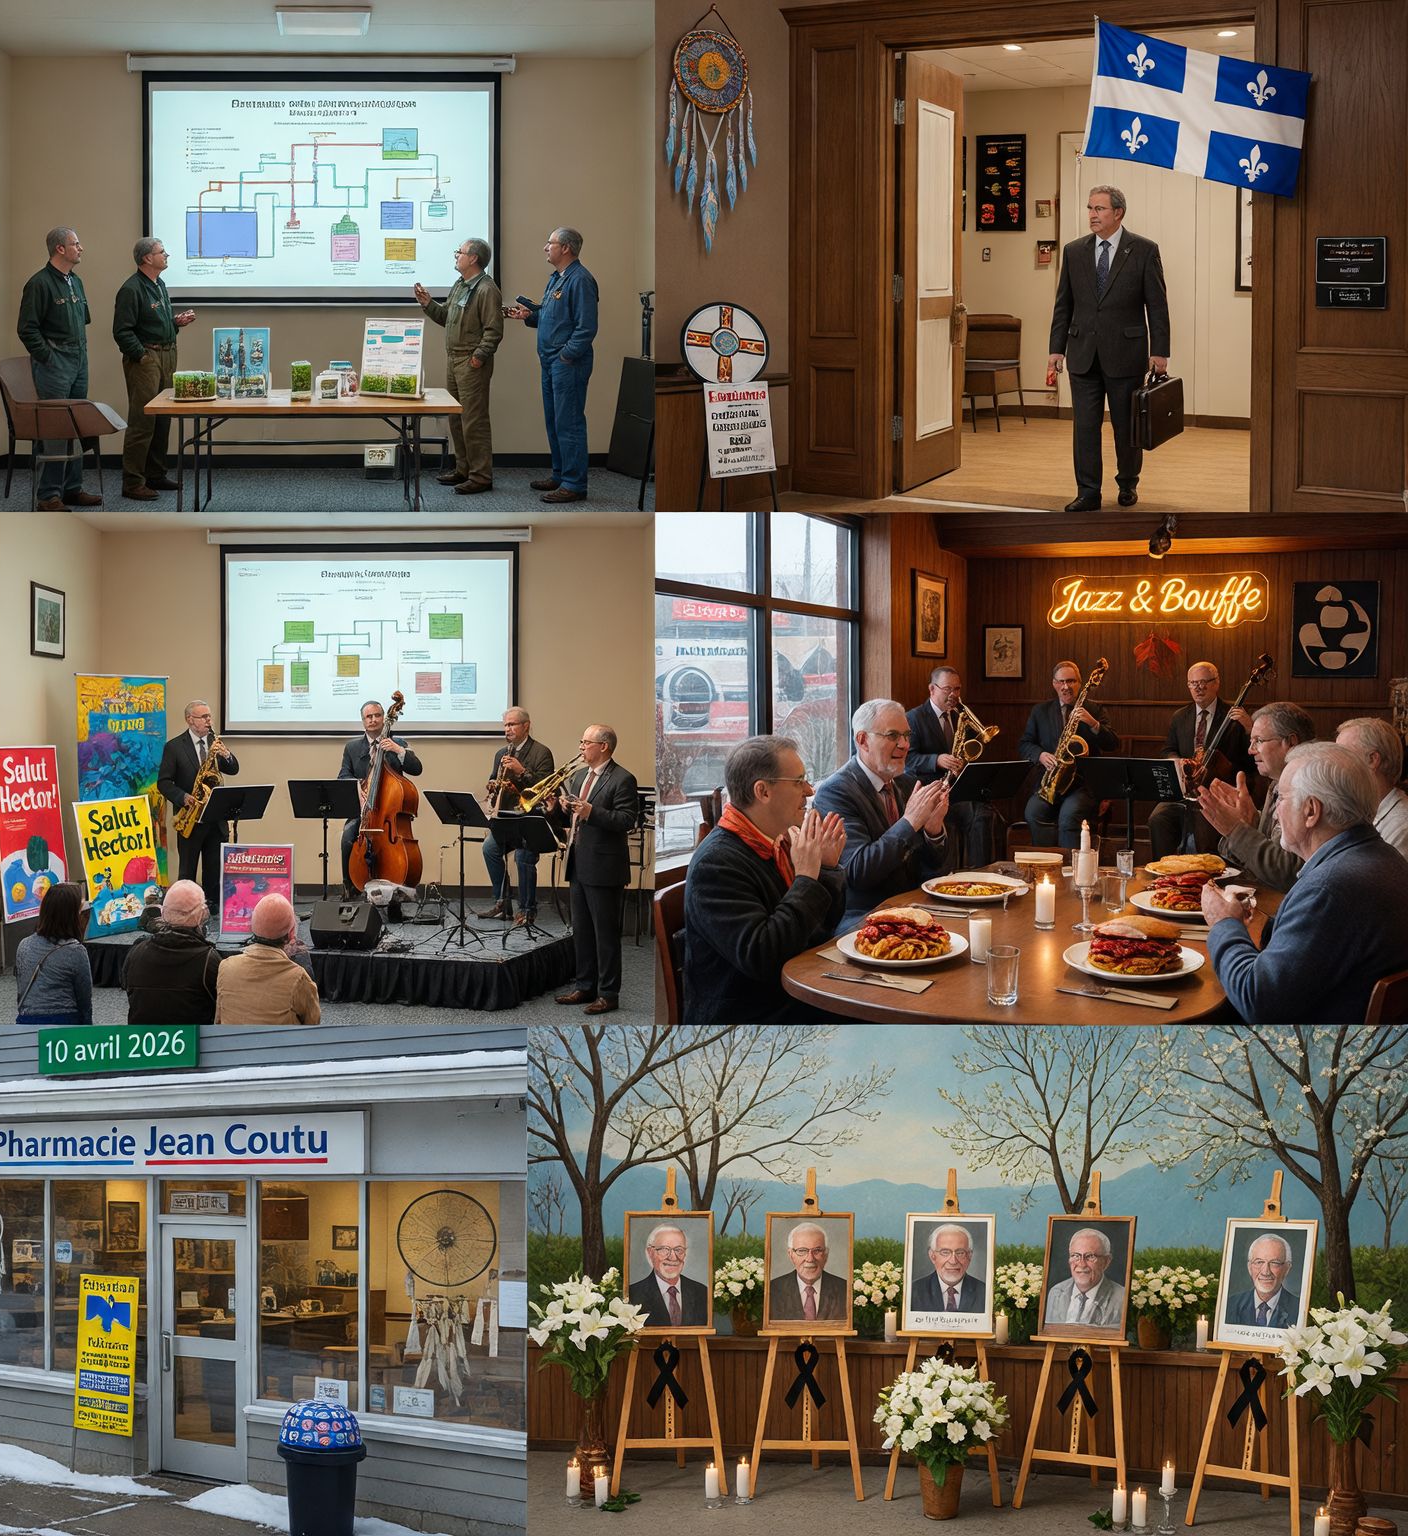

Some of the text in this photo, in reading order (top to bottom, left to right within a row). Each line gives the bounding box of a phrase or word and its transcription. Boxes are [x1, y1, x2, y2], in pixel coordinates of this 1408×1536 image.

[1052, 576, 1261, 625] Jazz & Bouffe
[2, 756, 48, 784] Salut
[0, 784, 57, 814] Hector!
[88, 805, 141, 835] Salut
[46, 1030, 186, 1064] 10 avril 2026
[144, 1125, 214, 1156] Jean
[224, 1123, 328, 1155] Coutu
